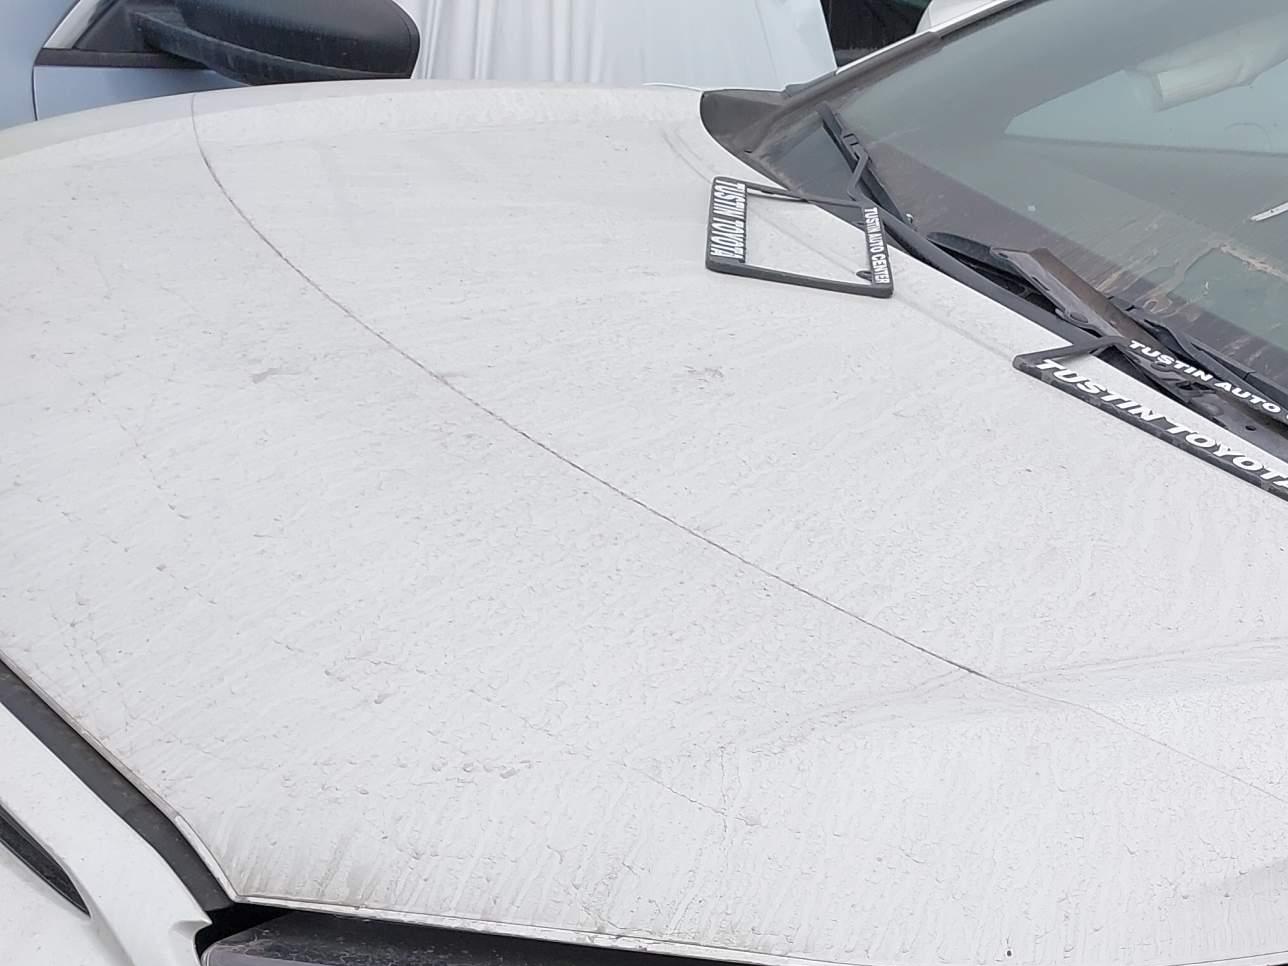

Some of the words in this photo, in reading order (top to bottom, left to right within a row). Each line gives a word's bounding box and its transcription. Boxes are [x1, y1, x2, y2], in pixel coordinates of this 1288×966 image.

[713, 180, 746, 221] TUSTIN
[710, 218, 745, 259] TOYOTA
[864, 207, 880, 236] TUSTIN
[869, 234, 884, 253] AUTO
[872, 254, 890, 284] CENTER
[1035, 359, 1167, 422] TUSTIN
[1128, 340, 1217, 381] TUSTIN
[1214, 381, 1282, 413] AUTO
